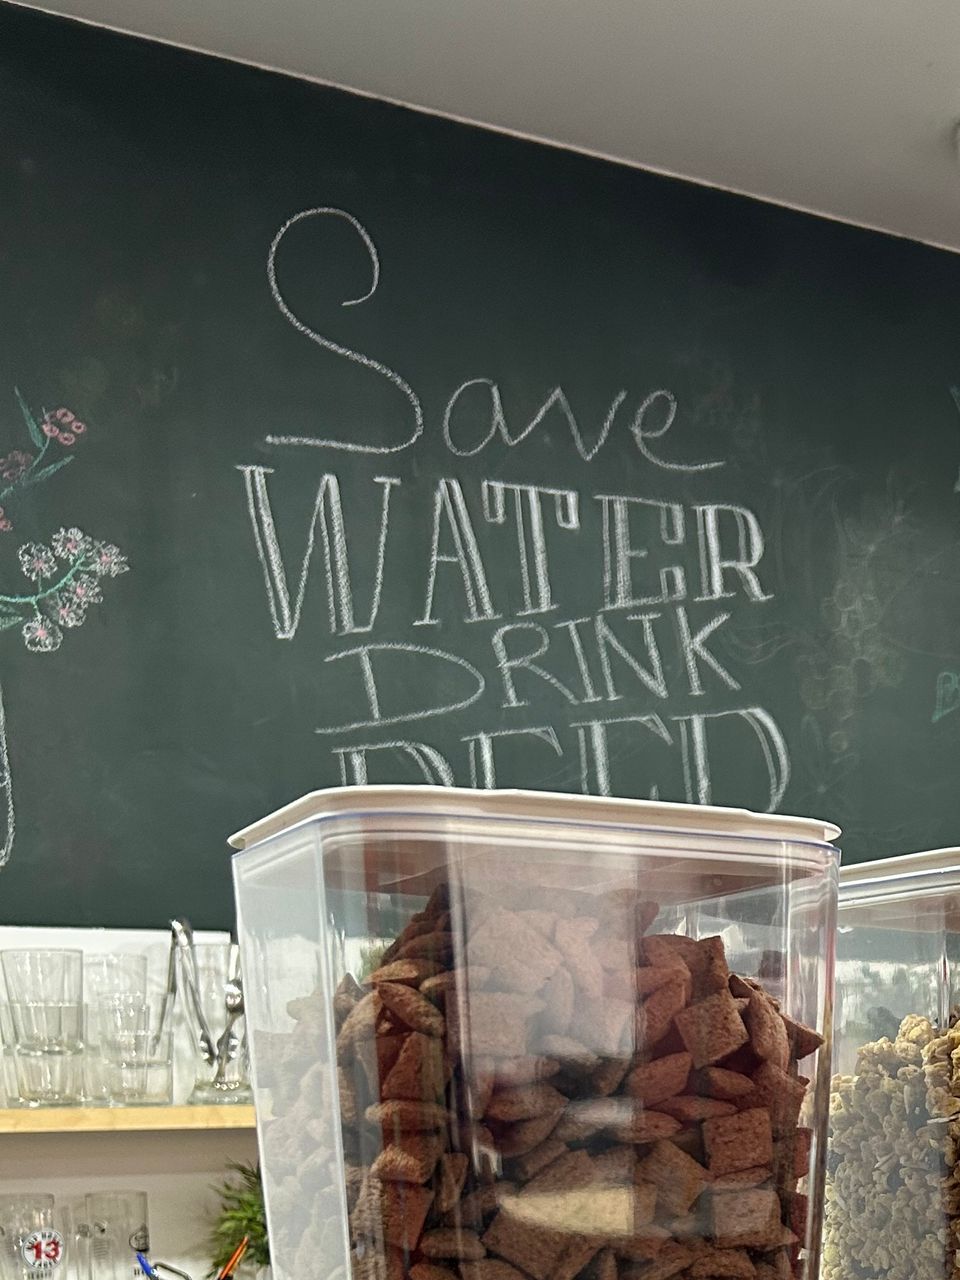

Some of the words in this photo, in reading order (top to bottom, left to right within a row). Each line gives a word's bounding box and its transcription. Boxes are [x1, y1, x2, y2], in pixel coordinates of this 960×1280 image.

[266, 206, 726, 472] Save
[234, 464, 774, 640] WATER
[315, 606, 741, 735] DRINK
[32, 1238, 60, 1260] 13
